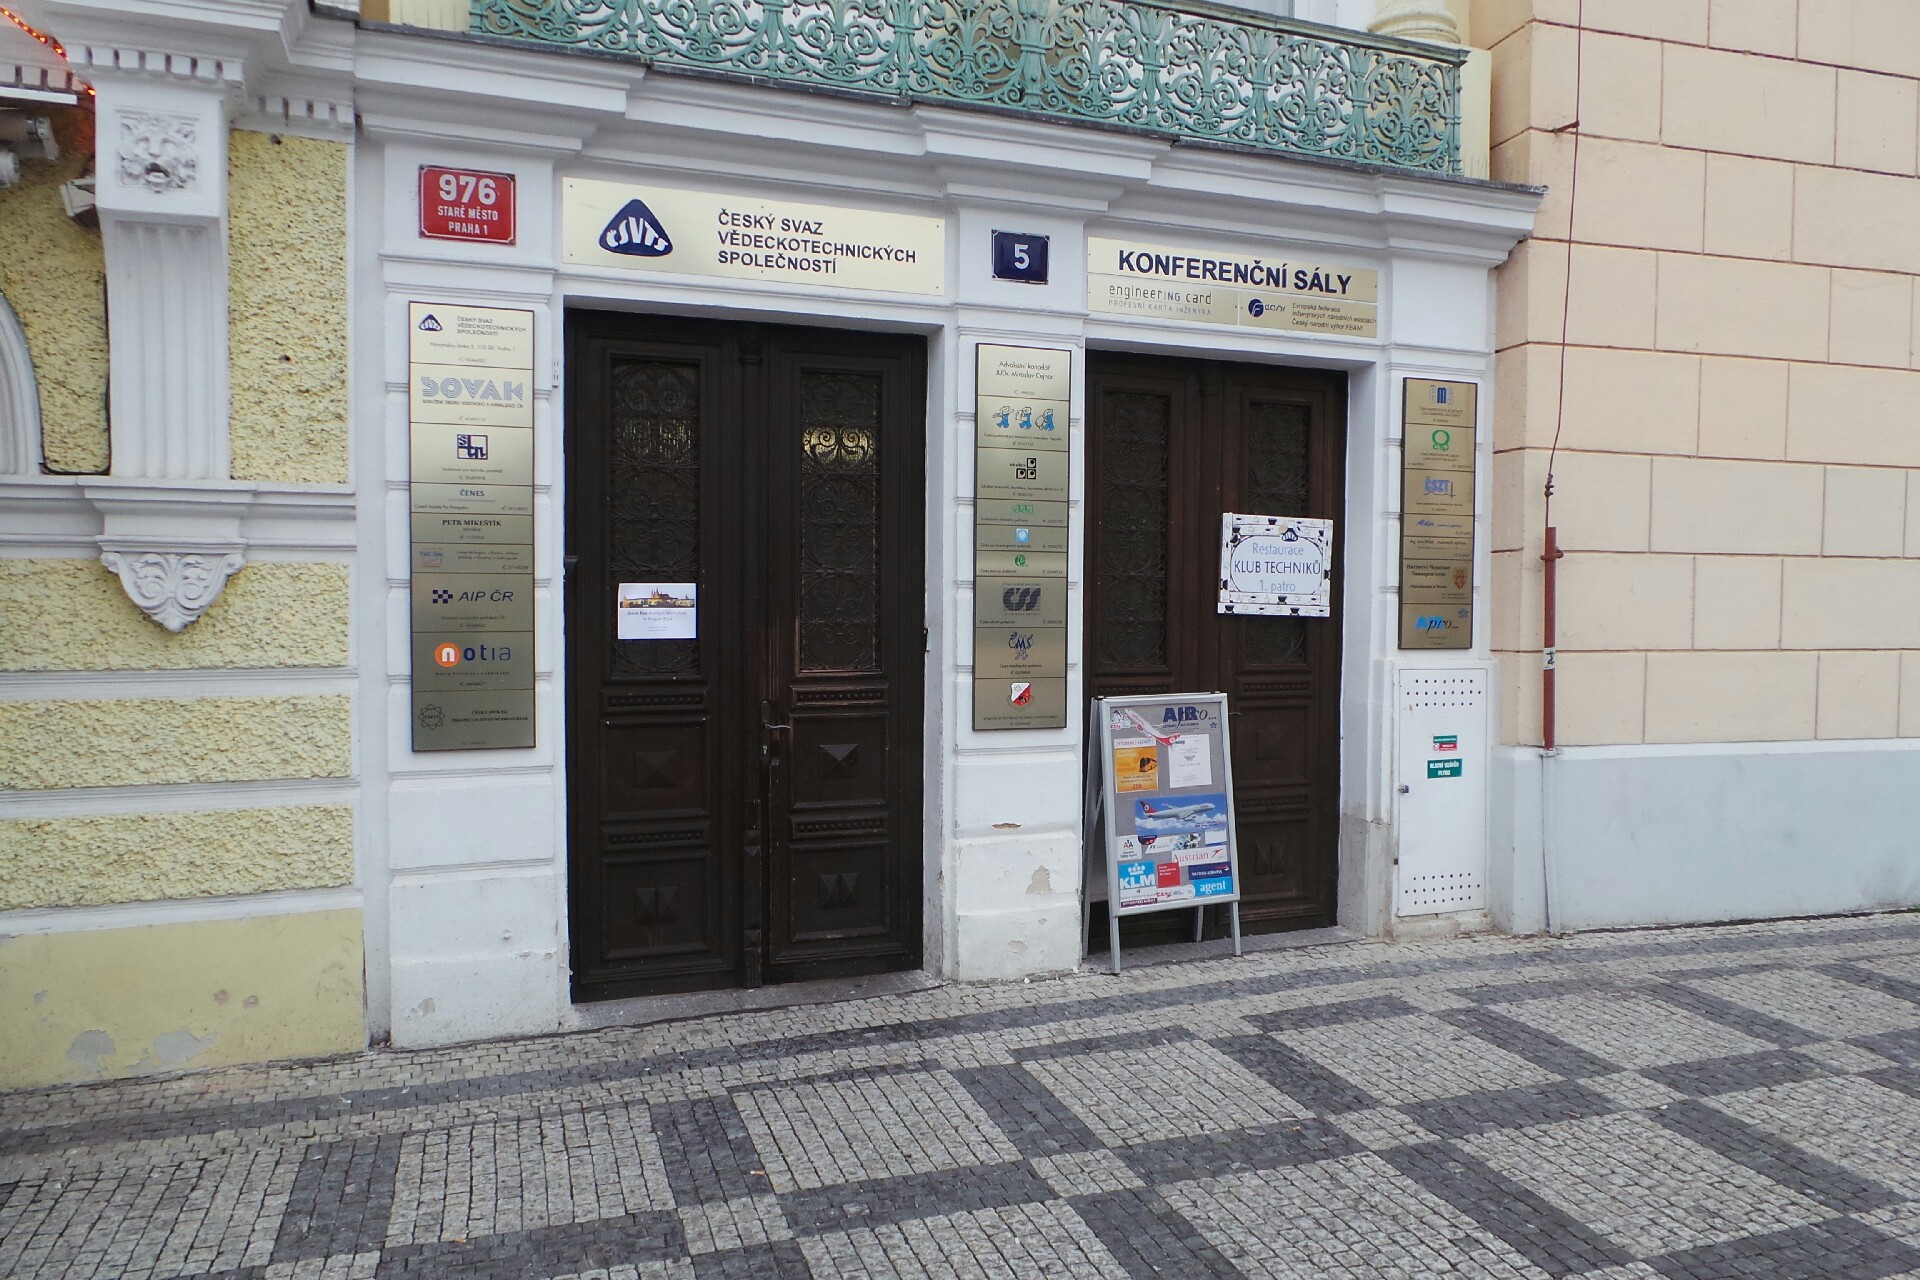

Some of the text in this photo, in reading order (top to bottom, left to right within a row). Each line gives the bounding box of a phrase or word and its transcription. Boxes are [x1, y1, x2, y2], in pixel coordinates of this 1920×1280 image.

[439, 173, 497, 206] 976
[437, 205, 499, 221] STARÉ MĚSTO
[448, 221, 488, 235] PRAHA 1
[718, 208, 824, 236] ČESKÝ SVAZ
[717, 231, 917, 264] VĚDECKOTECHNICKÝCH
[717, 250, 838, 274] SPOLEČNOSTÍ
[1014, 243, 1030, 270] 5
[1118, 249, 1352, 295] KONFERENČNÍ SÁLY
[1109, 285, 1212, 305] engineerING card
[1108, 299, 1146, 309] PROFESNÍ
[1148, 303, 1173, 312] KARTA
[1291, 318, 1309, 328] Český
[420, 376, 524, 401] SOVAK
[459, 488, 485, 497] ČENES
[1252, 543, 1304, 556] Restaurace
[1234, 559, 1321, 575] KLUB TECHNIKŮ
[1259, 580, 1296, 593] 1. patro
[458, 589, 514, 602] AIP ČR
[1172, 851, 1209, 863] Austrian
[1119, 873, 1156, 890] KLM
[1199, 880, 1227, 895] agent
